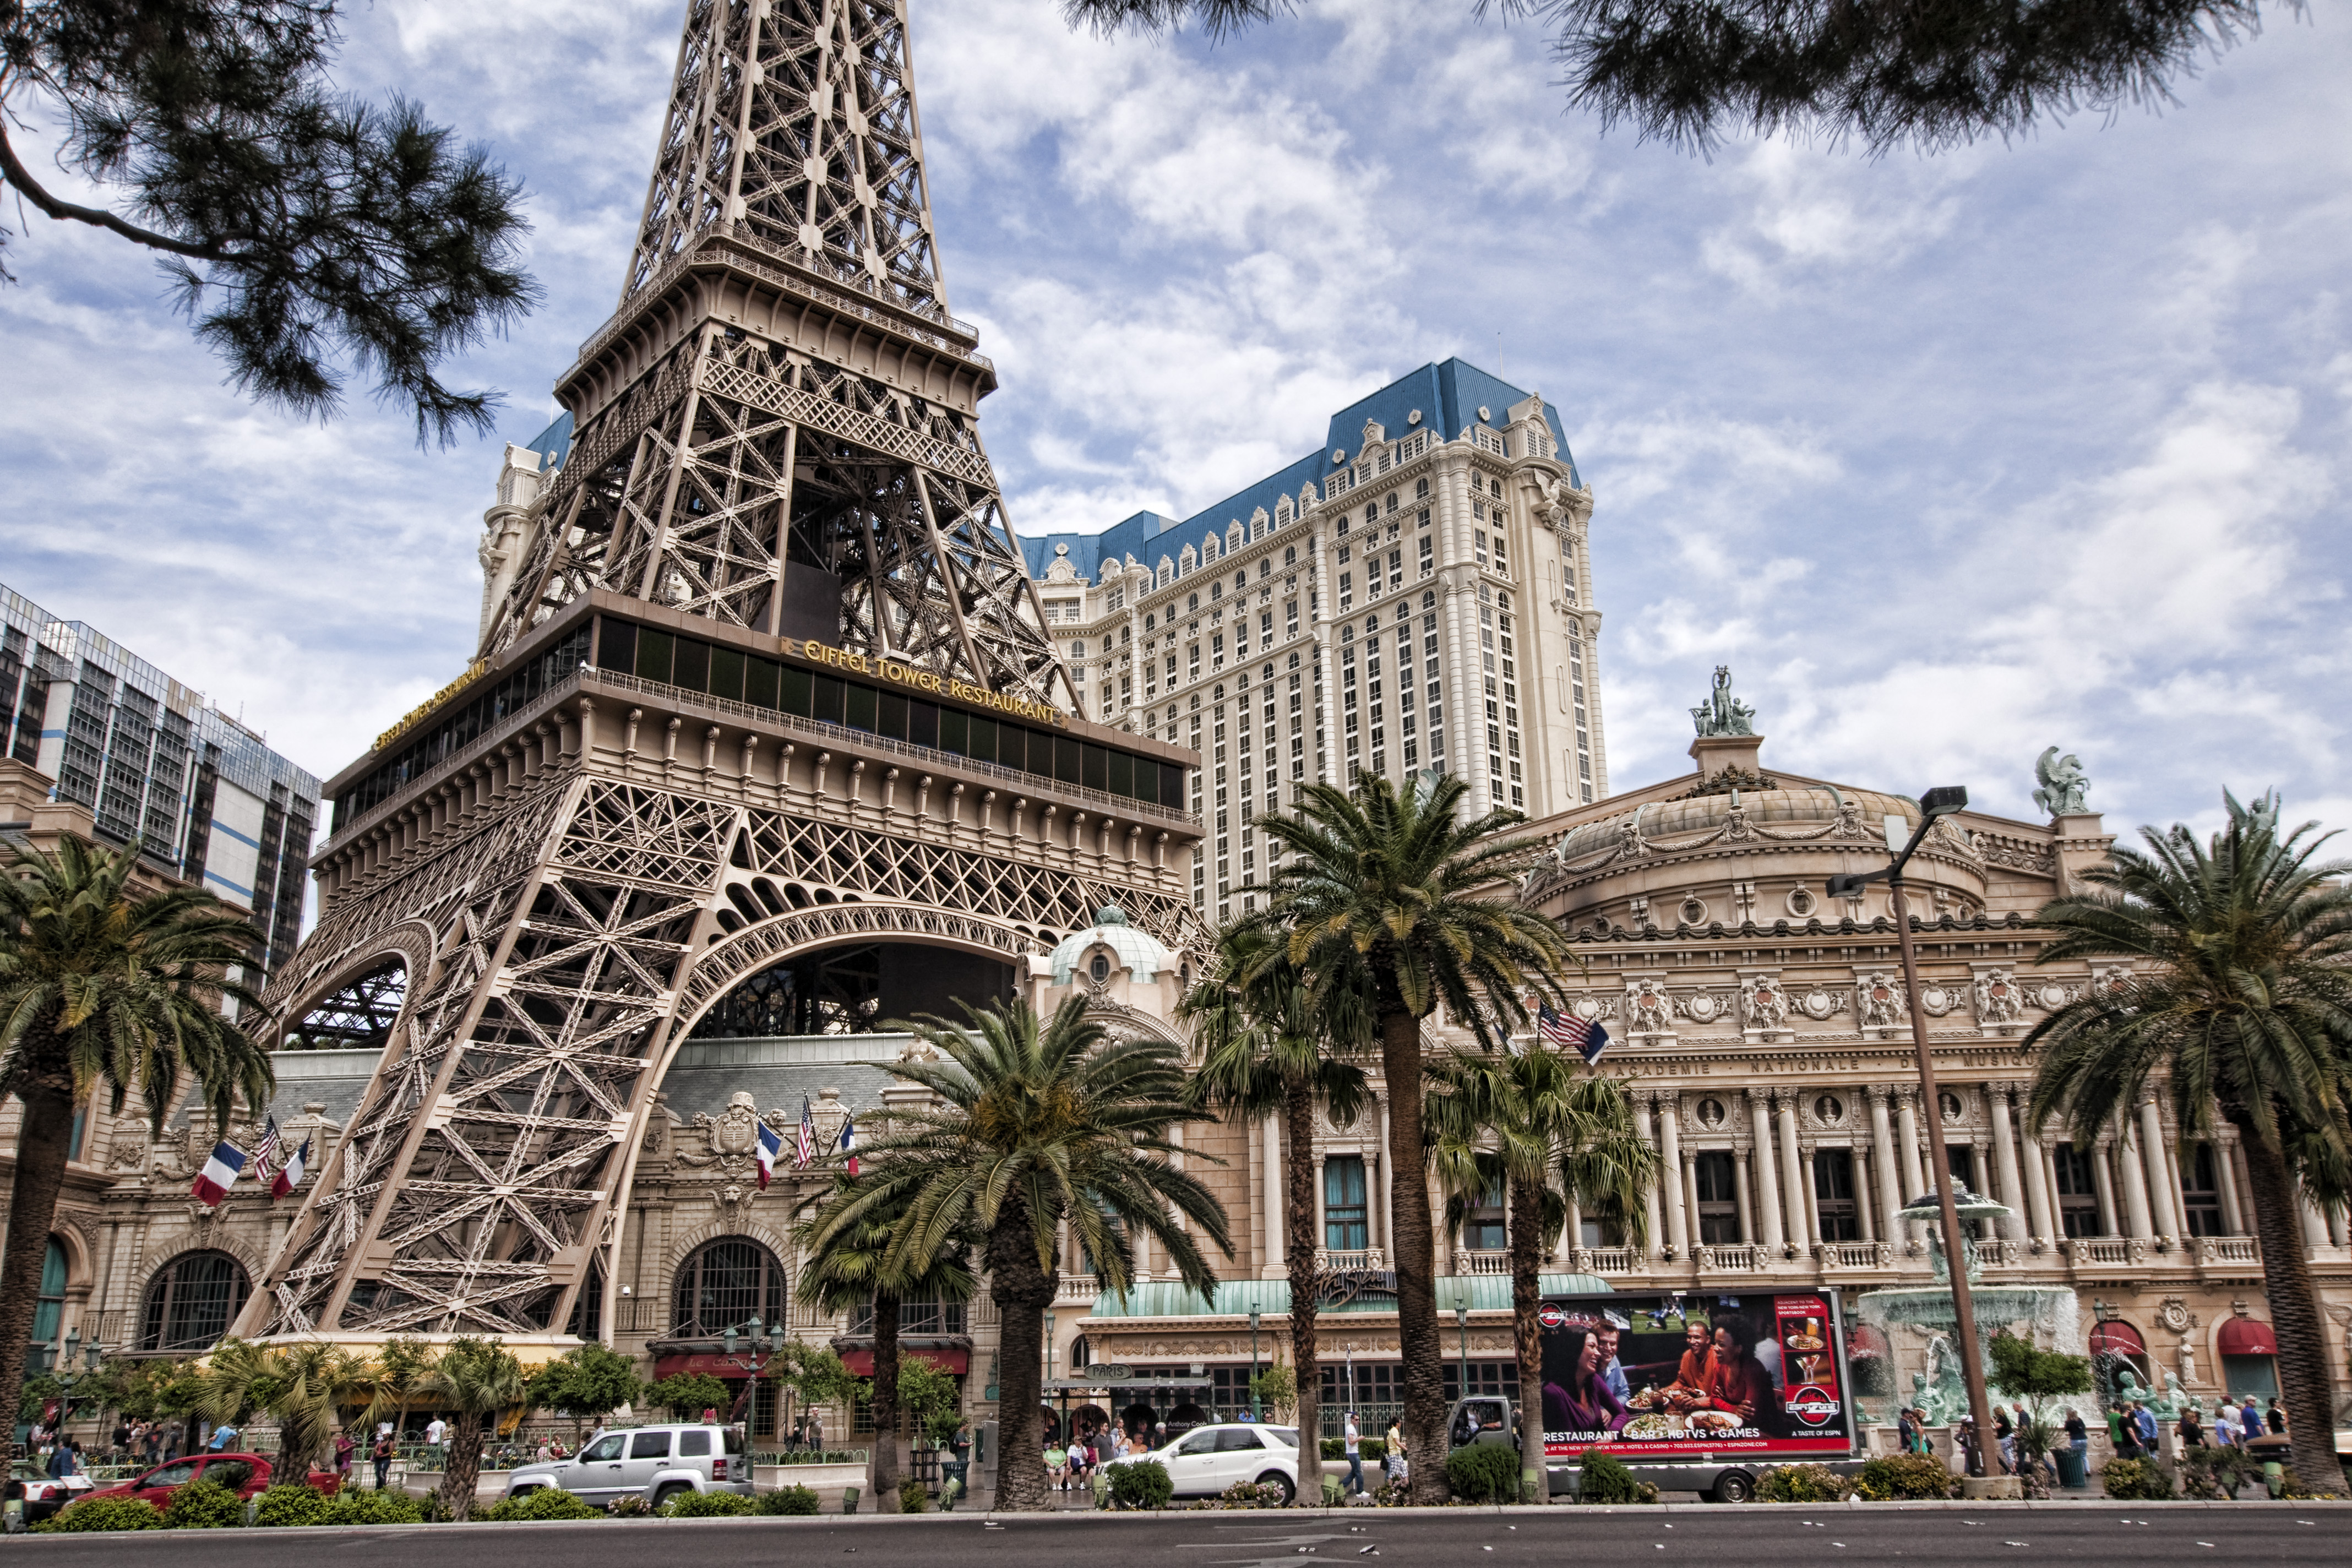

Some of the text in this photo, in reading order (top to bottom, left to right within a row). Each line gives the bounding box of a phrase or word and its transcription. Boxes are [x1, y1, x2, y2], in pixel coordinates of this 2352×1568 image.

[803, 640, 1056, 723] EIFFEL TOWER RESTAURANT
[402, 699, 431, 731] TOWER
[432, 657, 489, 709] RESTAURANT
[1615, 1064, 1710, 1076] ACADEMIE
[1751, 1060, 1859, 1072] NATIONALE
[1963, 1055, 2033, 1067] MUSIQU
[688, 1358, 704, 1367] Le
[1093, 1365, 1124, 1378] PARIS
[1543, 1428, 1760, 1442] RESTAURANT BAR HDTVS GAMES
